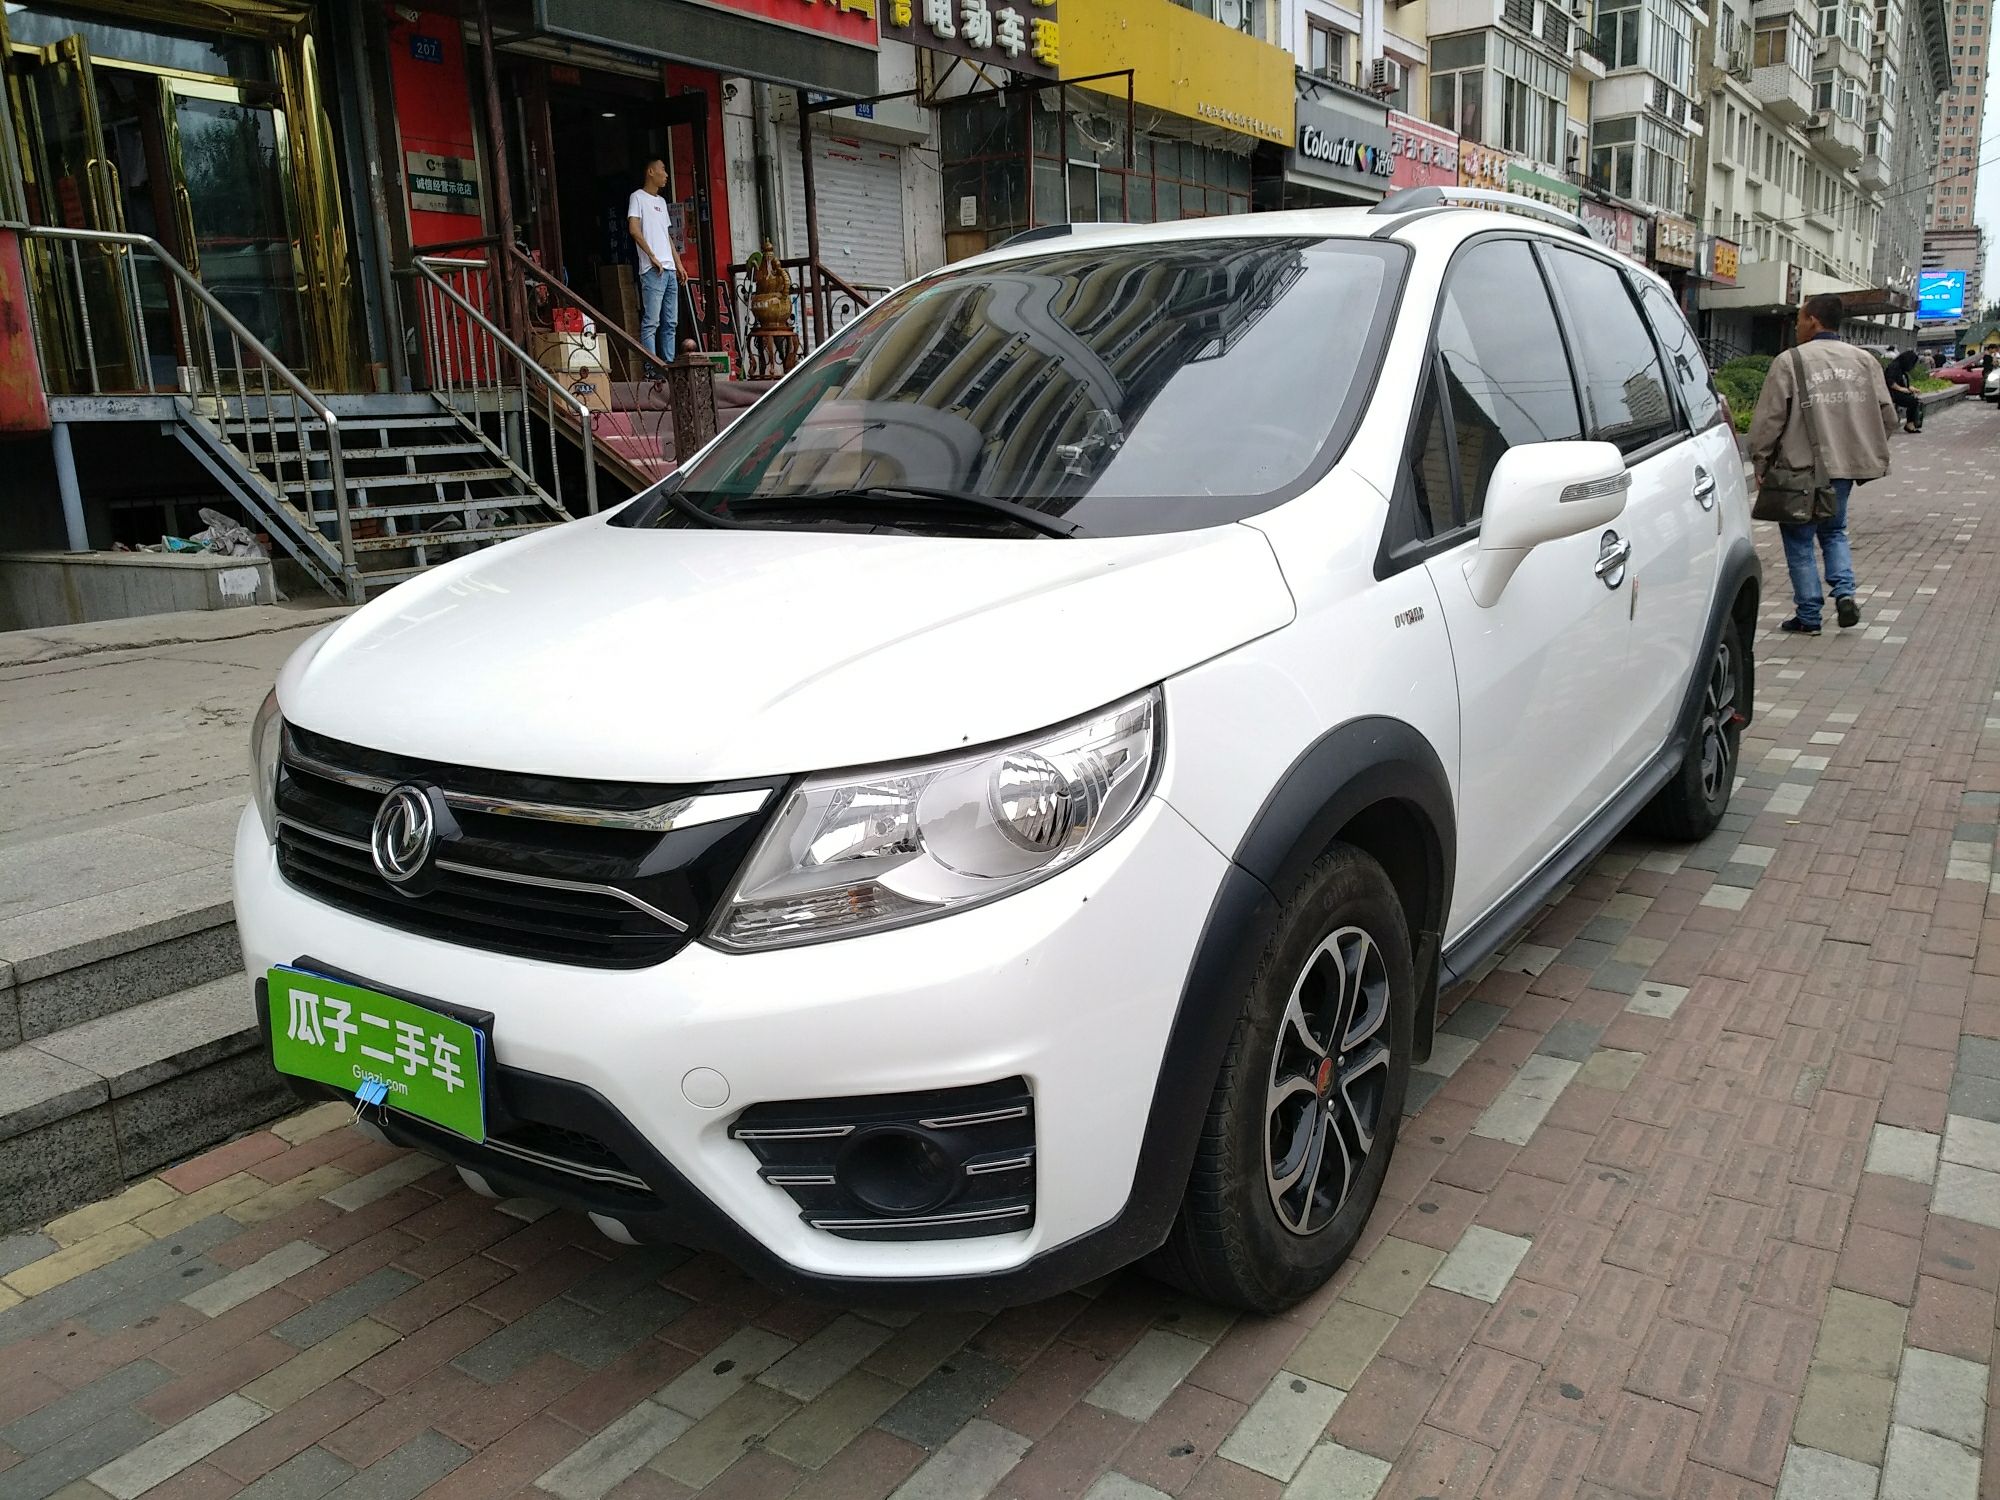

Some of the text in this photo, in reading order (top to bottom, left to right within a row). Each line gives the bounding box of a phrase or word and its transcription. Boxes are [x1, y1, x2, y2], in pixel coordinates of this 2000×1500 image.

[923, 0, 1026, 59] 电动车
[416, 42, 436, 57] 207
[1304, 125, 1357, 167] Colourful
[416, 177, 472, 196] 诚信经营示范店
[287, 988, 465, 1093] 瓜子二手车
[352, 1064, 408, 1096] Guazicom
